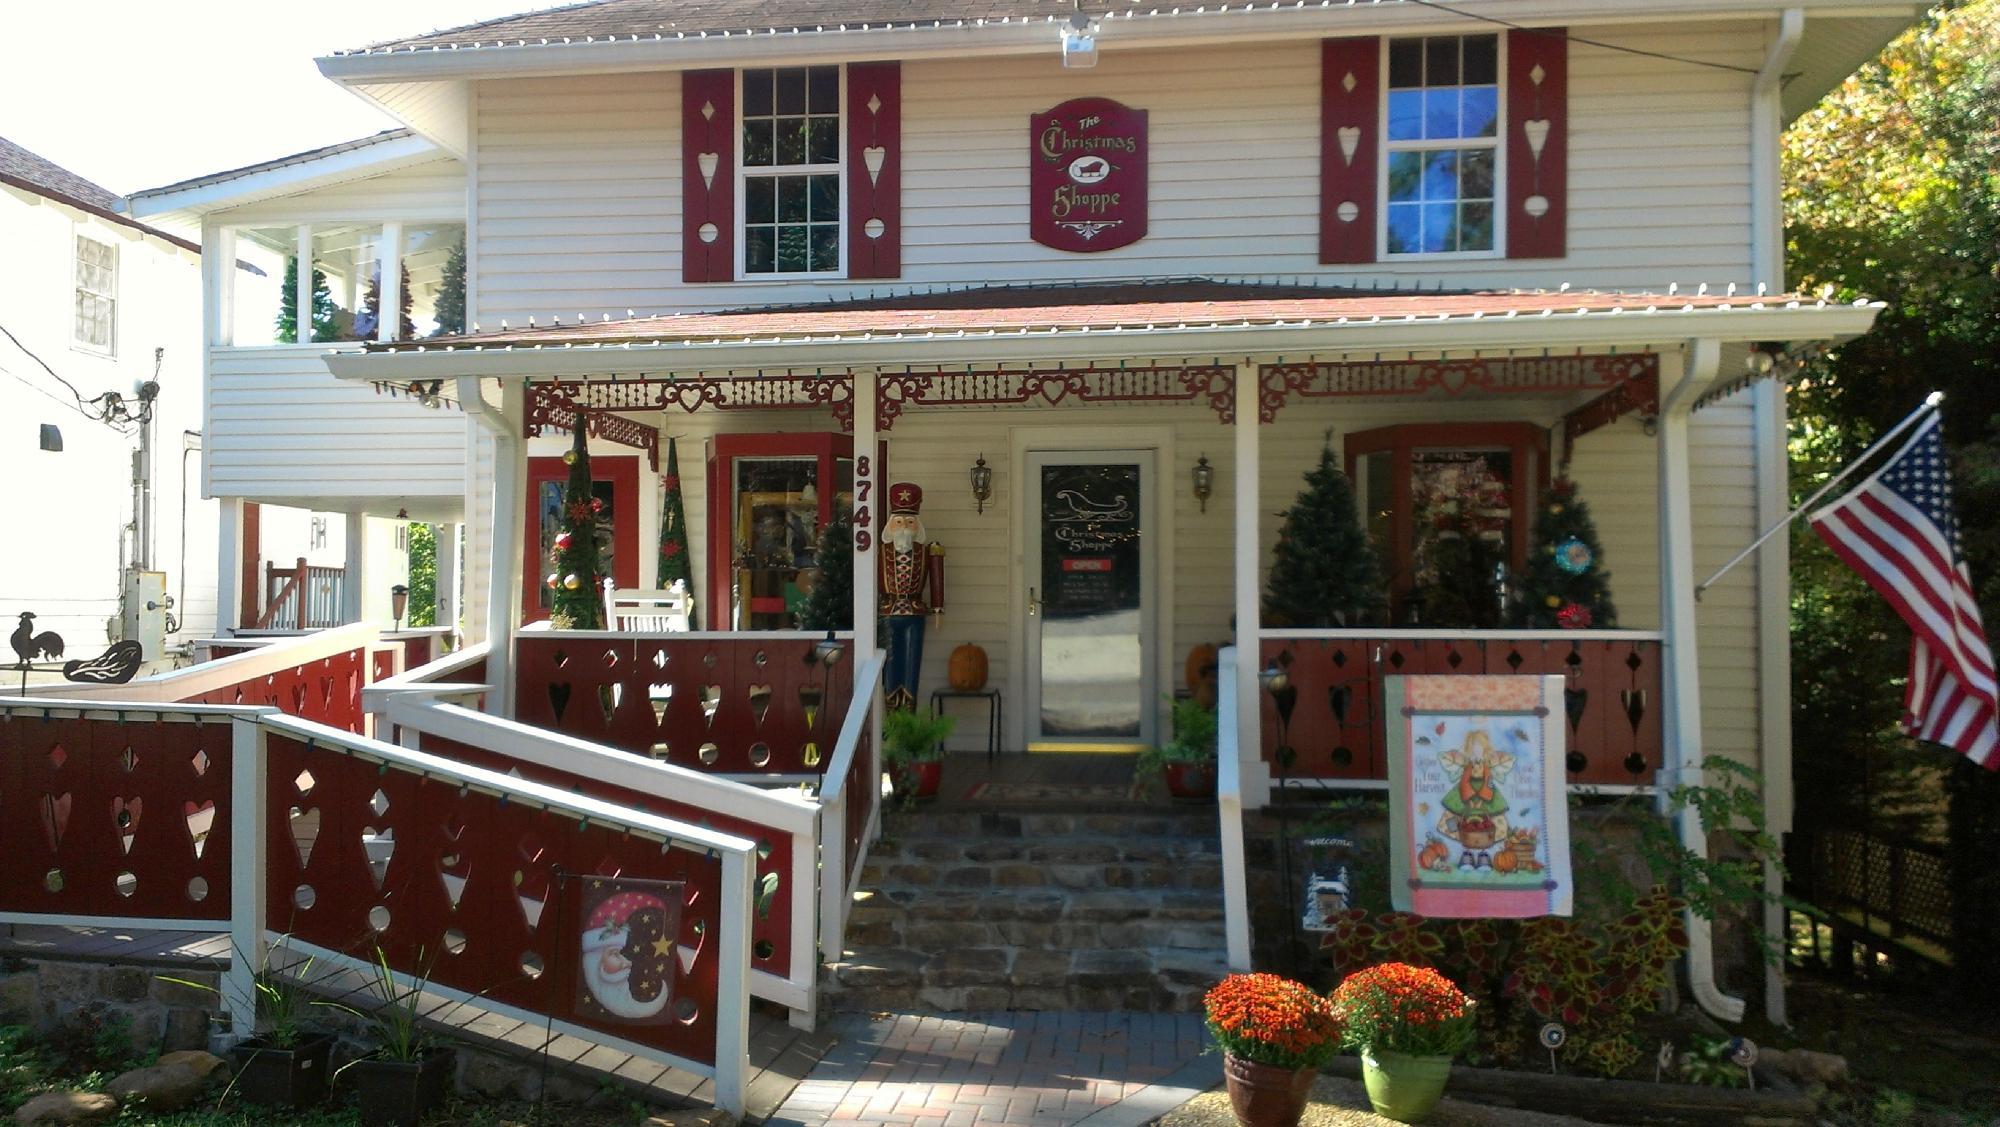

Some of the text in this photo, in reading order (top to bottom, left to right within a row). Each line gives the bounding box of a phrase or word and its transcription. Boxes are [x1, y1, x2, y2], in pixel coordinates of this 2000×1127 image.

[1079, 116, 1100, 130] The
[1040, 122, 1136, 160] Christmas
[1052, 184, 1121, 217] Shoppe
[853, 455, 872, 552] 8749
